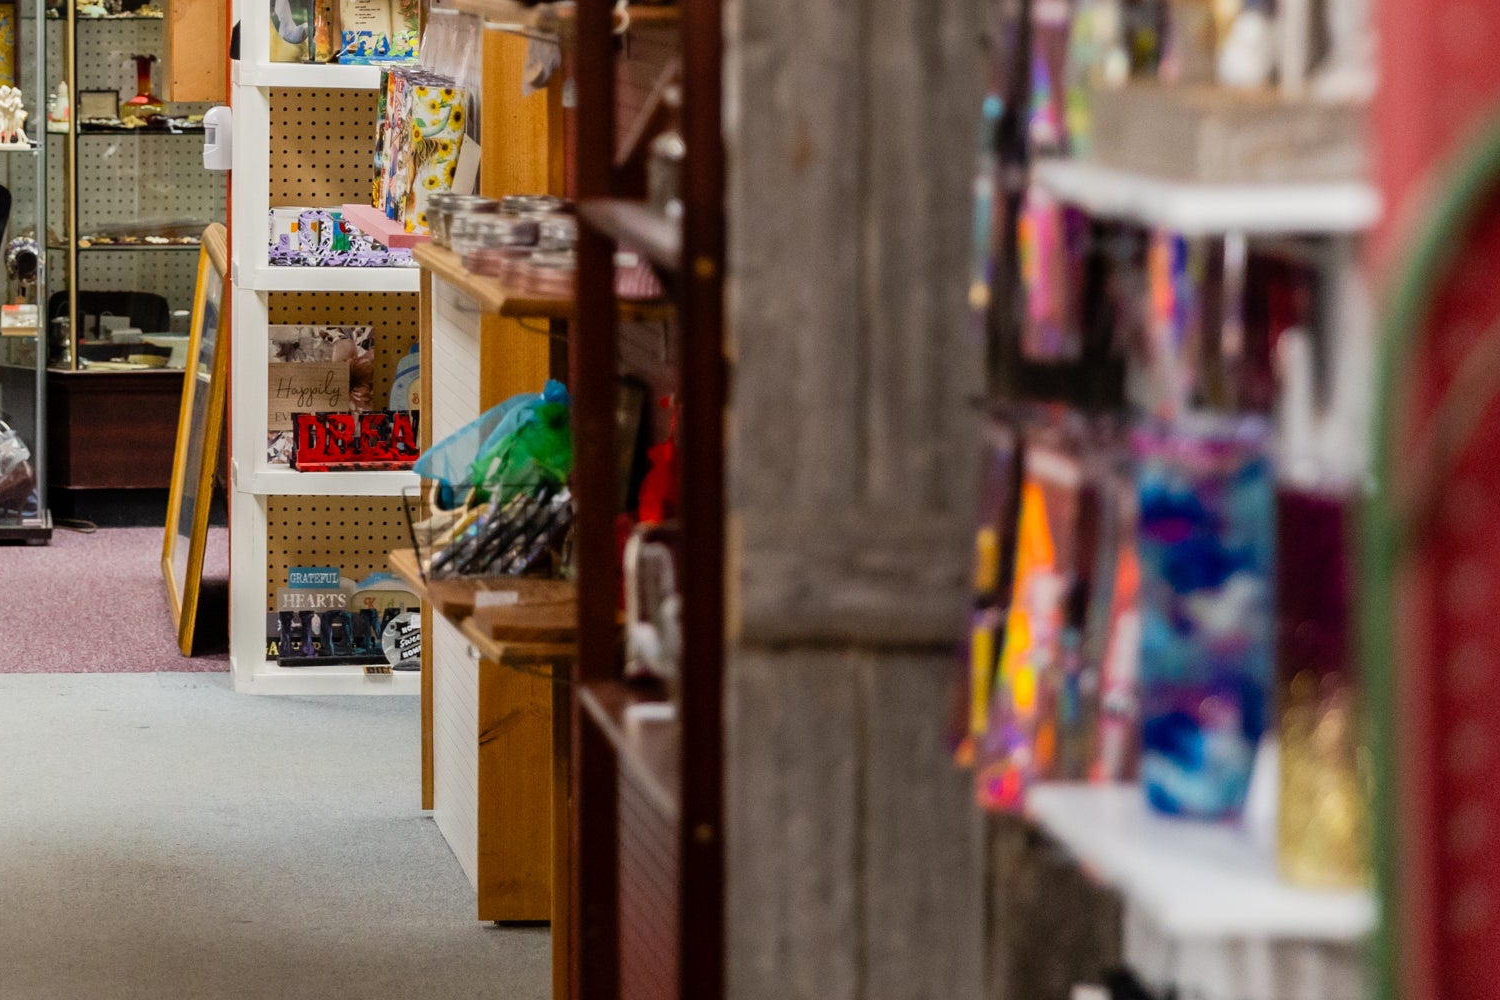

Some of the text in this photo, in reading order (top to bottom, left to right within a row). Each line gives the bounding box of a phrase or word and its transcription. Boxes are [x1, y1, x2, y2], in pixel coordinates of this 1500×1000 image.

[276, 370, 341, 407] Happily
[296, 412, 419, 456] DREA
[289, 572, 340, 584] GRATEFUL
[283, 593, 348, 608] HEARTS
